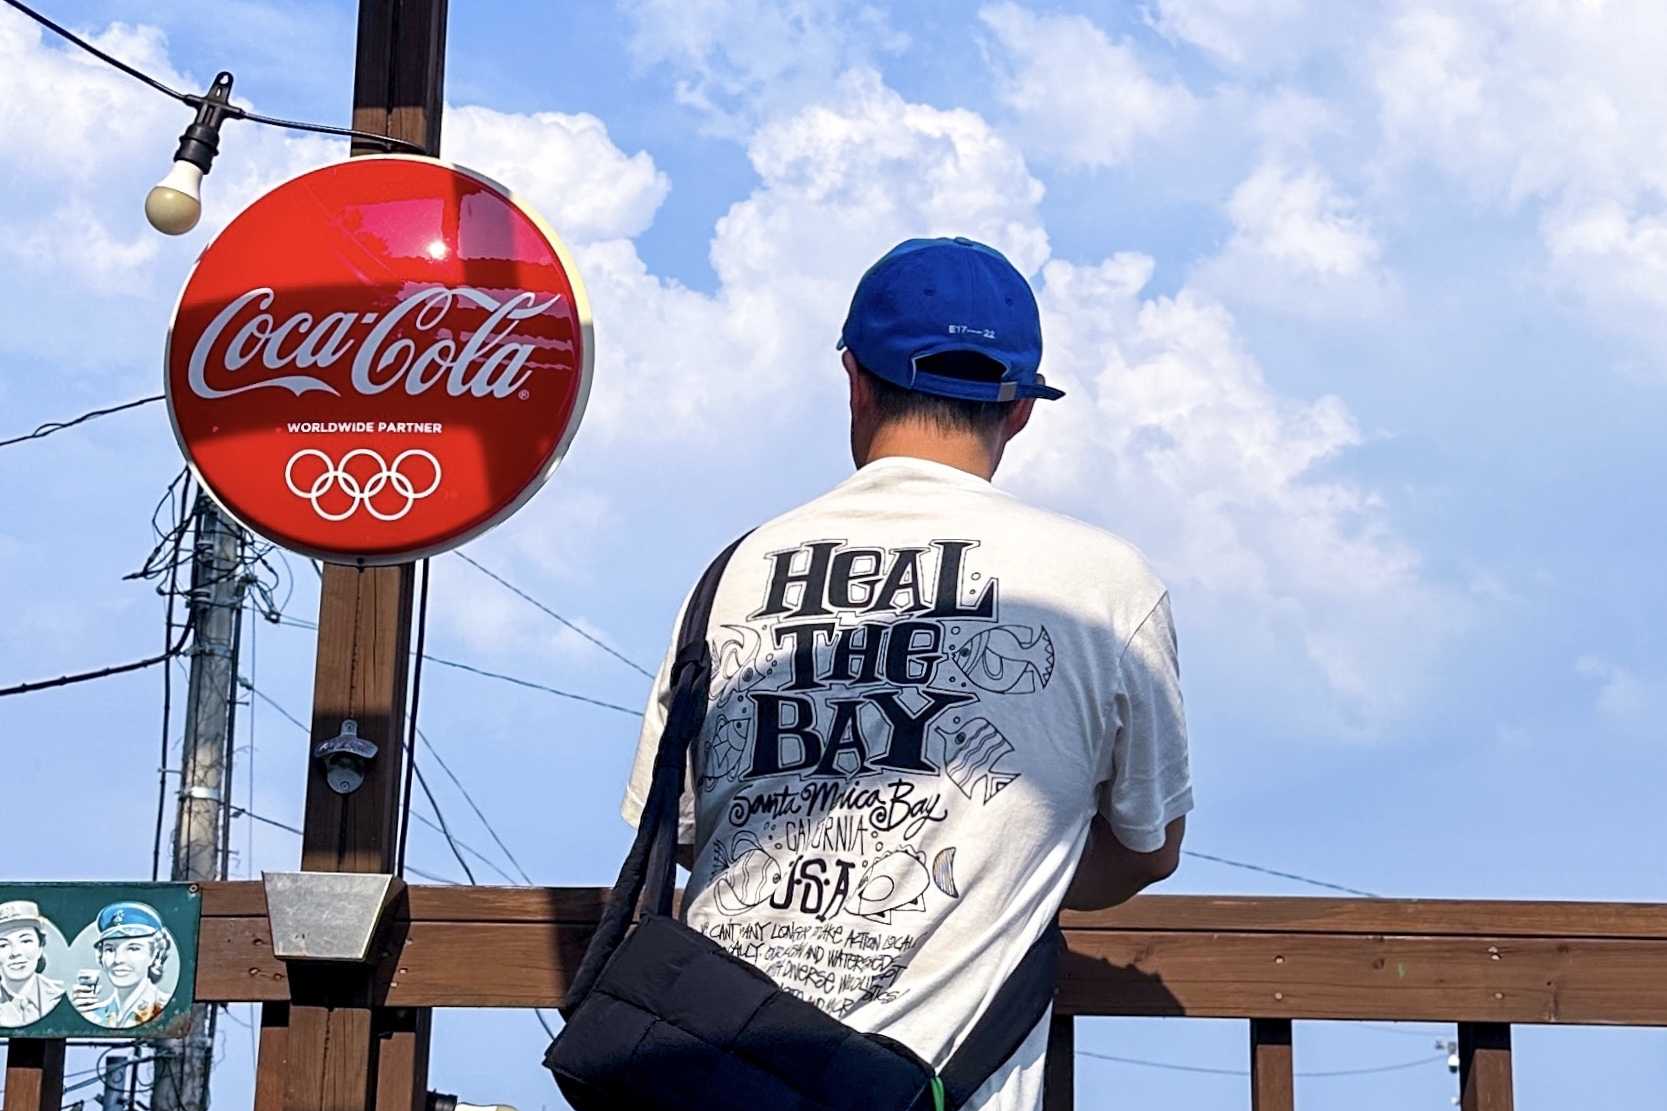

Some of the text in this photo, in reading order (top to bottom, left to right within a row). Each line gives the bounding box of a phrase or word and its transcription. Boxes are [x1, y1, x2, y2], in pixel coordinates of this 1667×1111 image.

[188, 287, 561, 398] Coca-Cola
[287, 421, 443, 434] WORLDWIDE PARTNER
[739, 689, 980, 780] BAY
[728, 784, 802, 827] Santa
[869, 778, 948, 840] Bay
